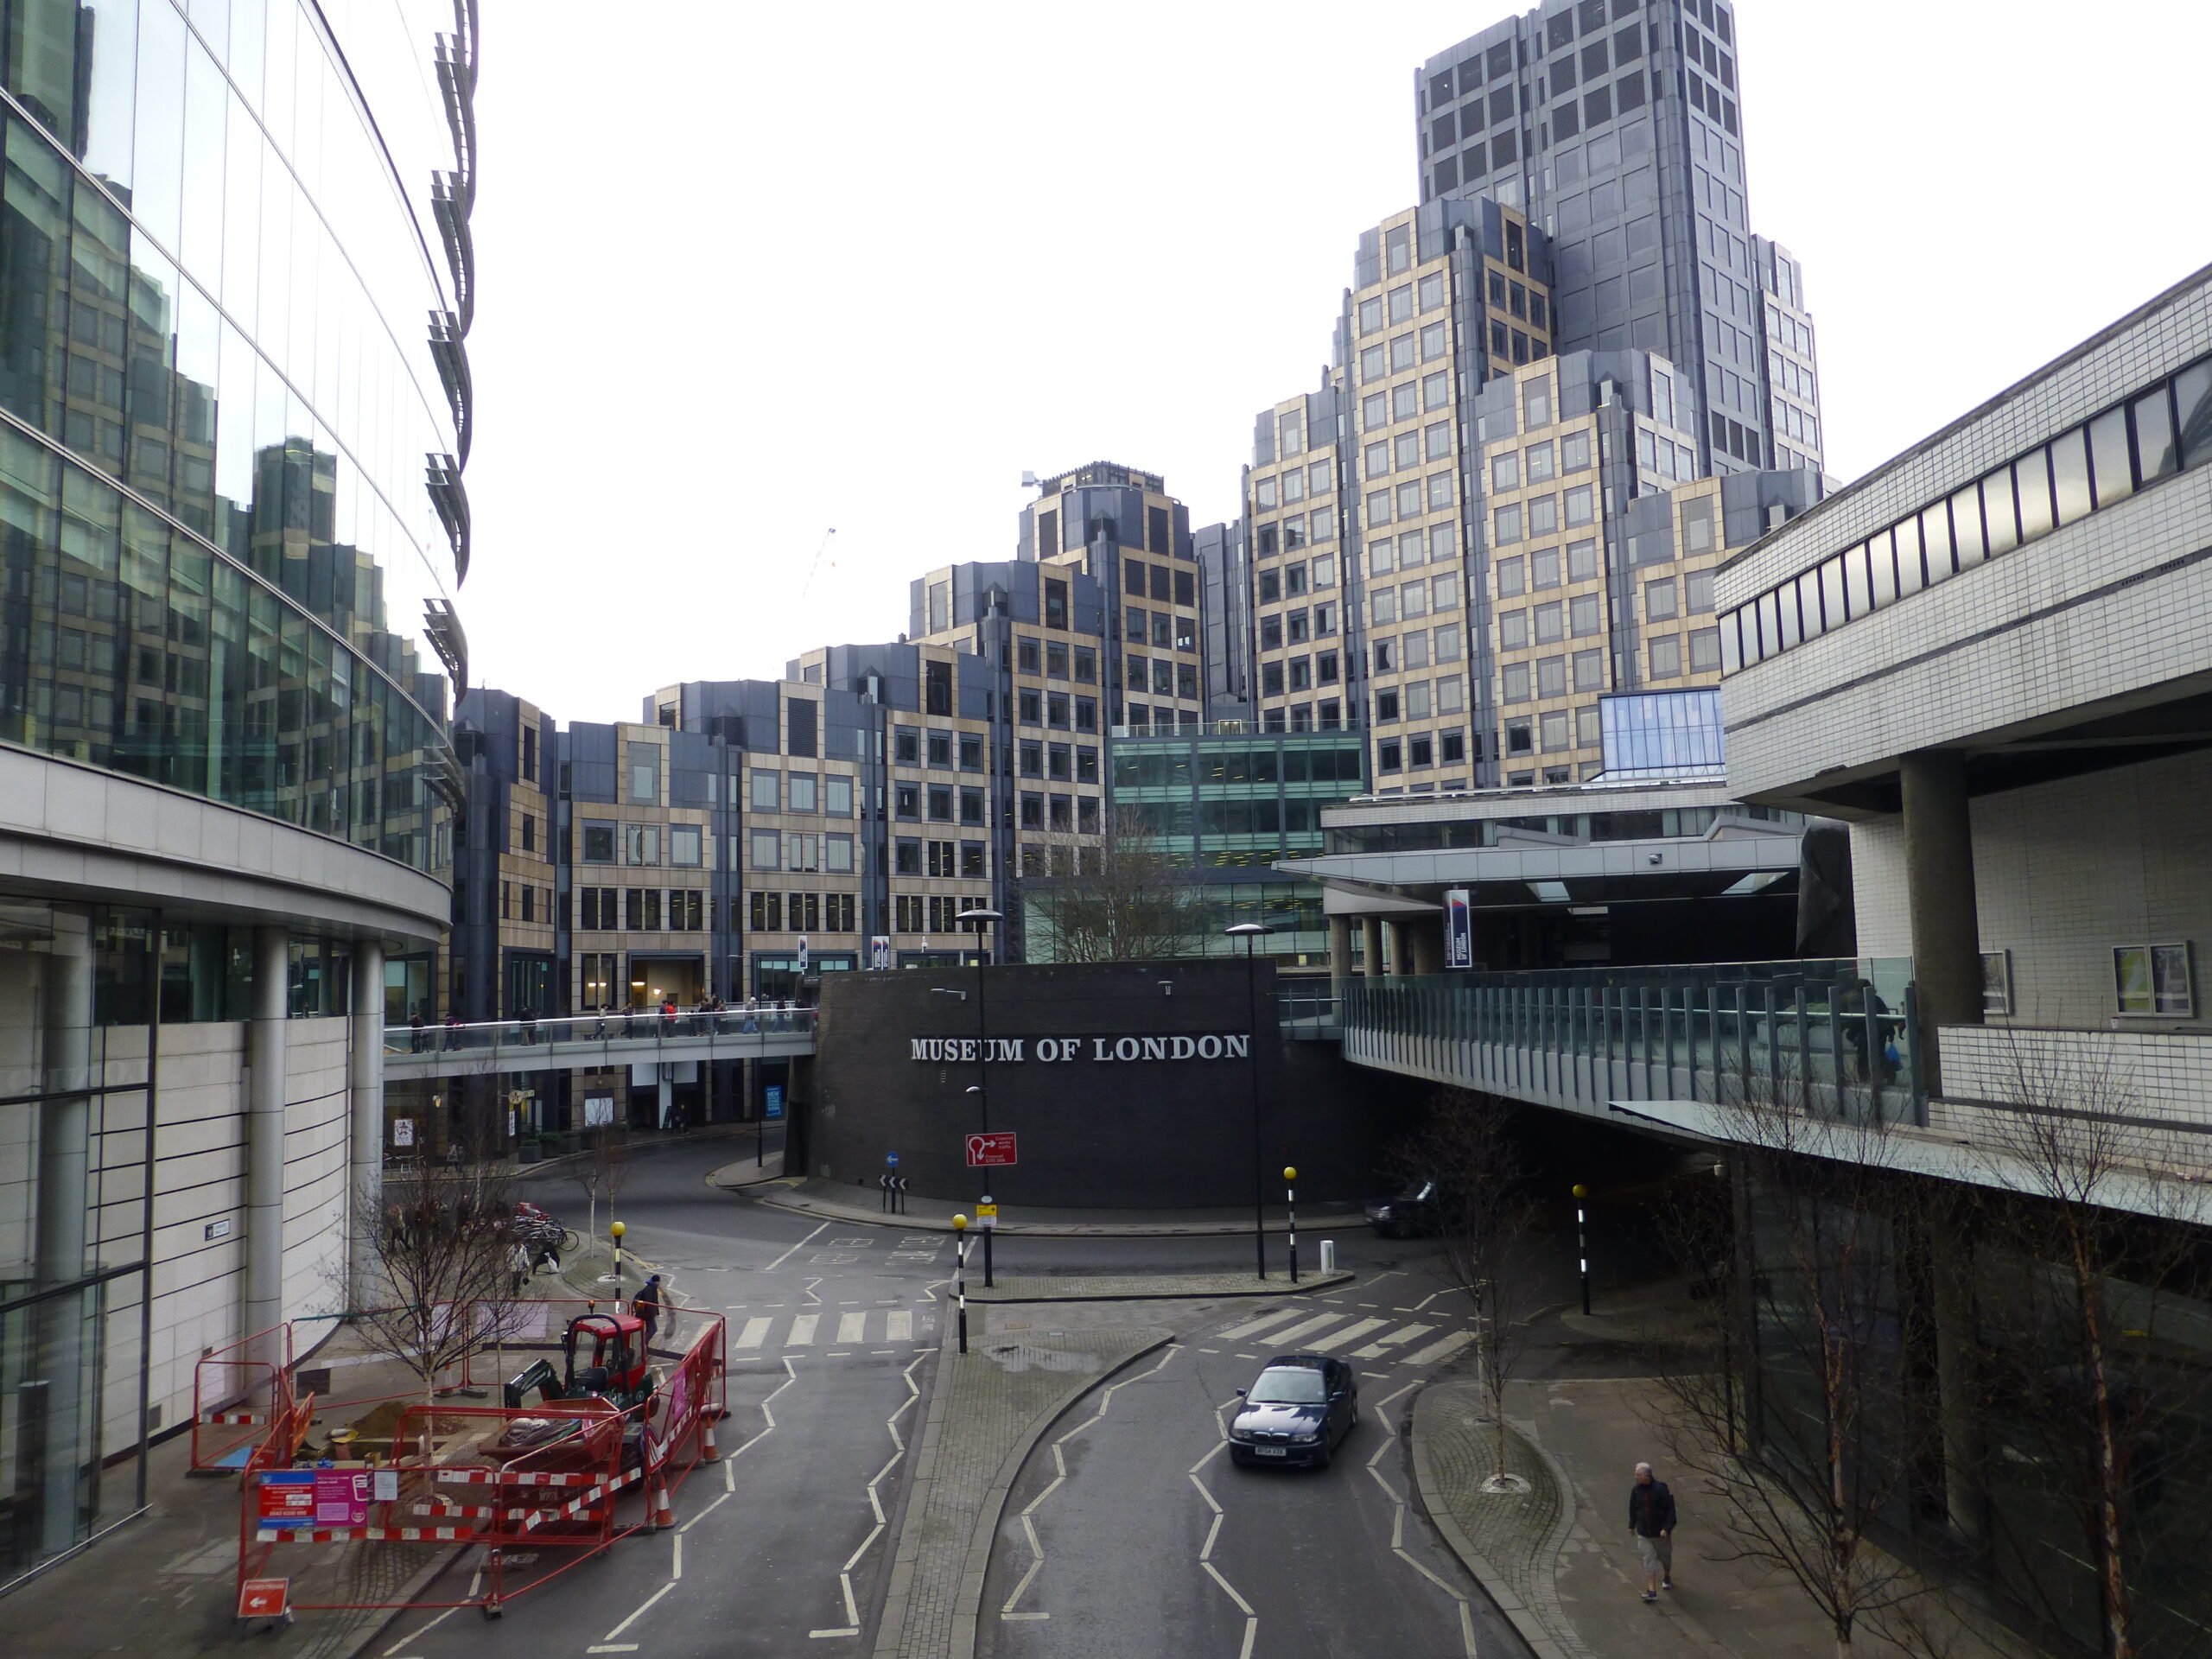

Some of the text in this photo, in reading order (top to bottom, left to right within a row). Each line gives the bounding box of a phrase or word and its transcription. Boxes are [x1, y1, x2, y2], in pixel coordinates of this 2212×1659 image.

[911, 1034, 1249, 1062] MUSEUM OF LONDON
